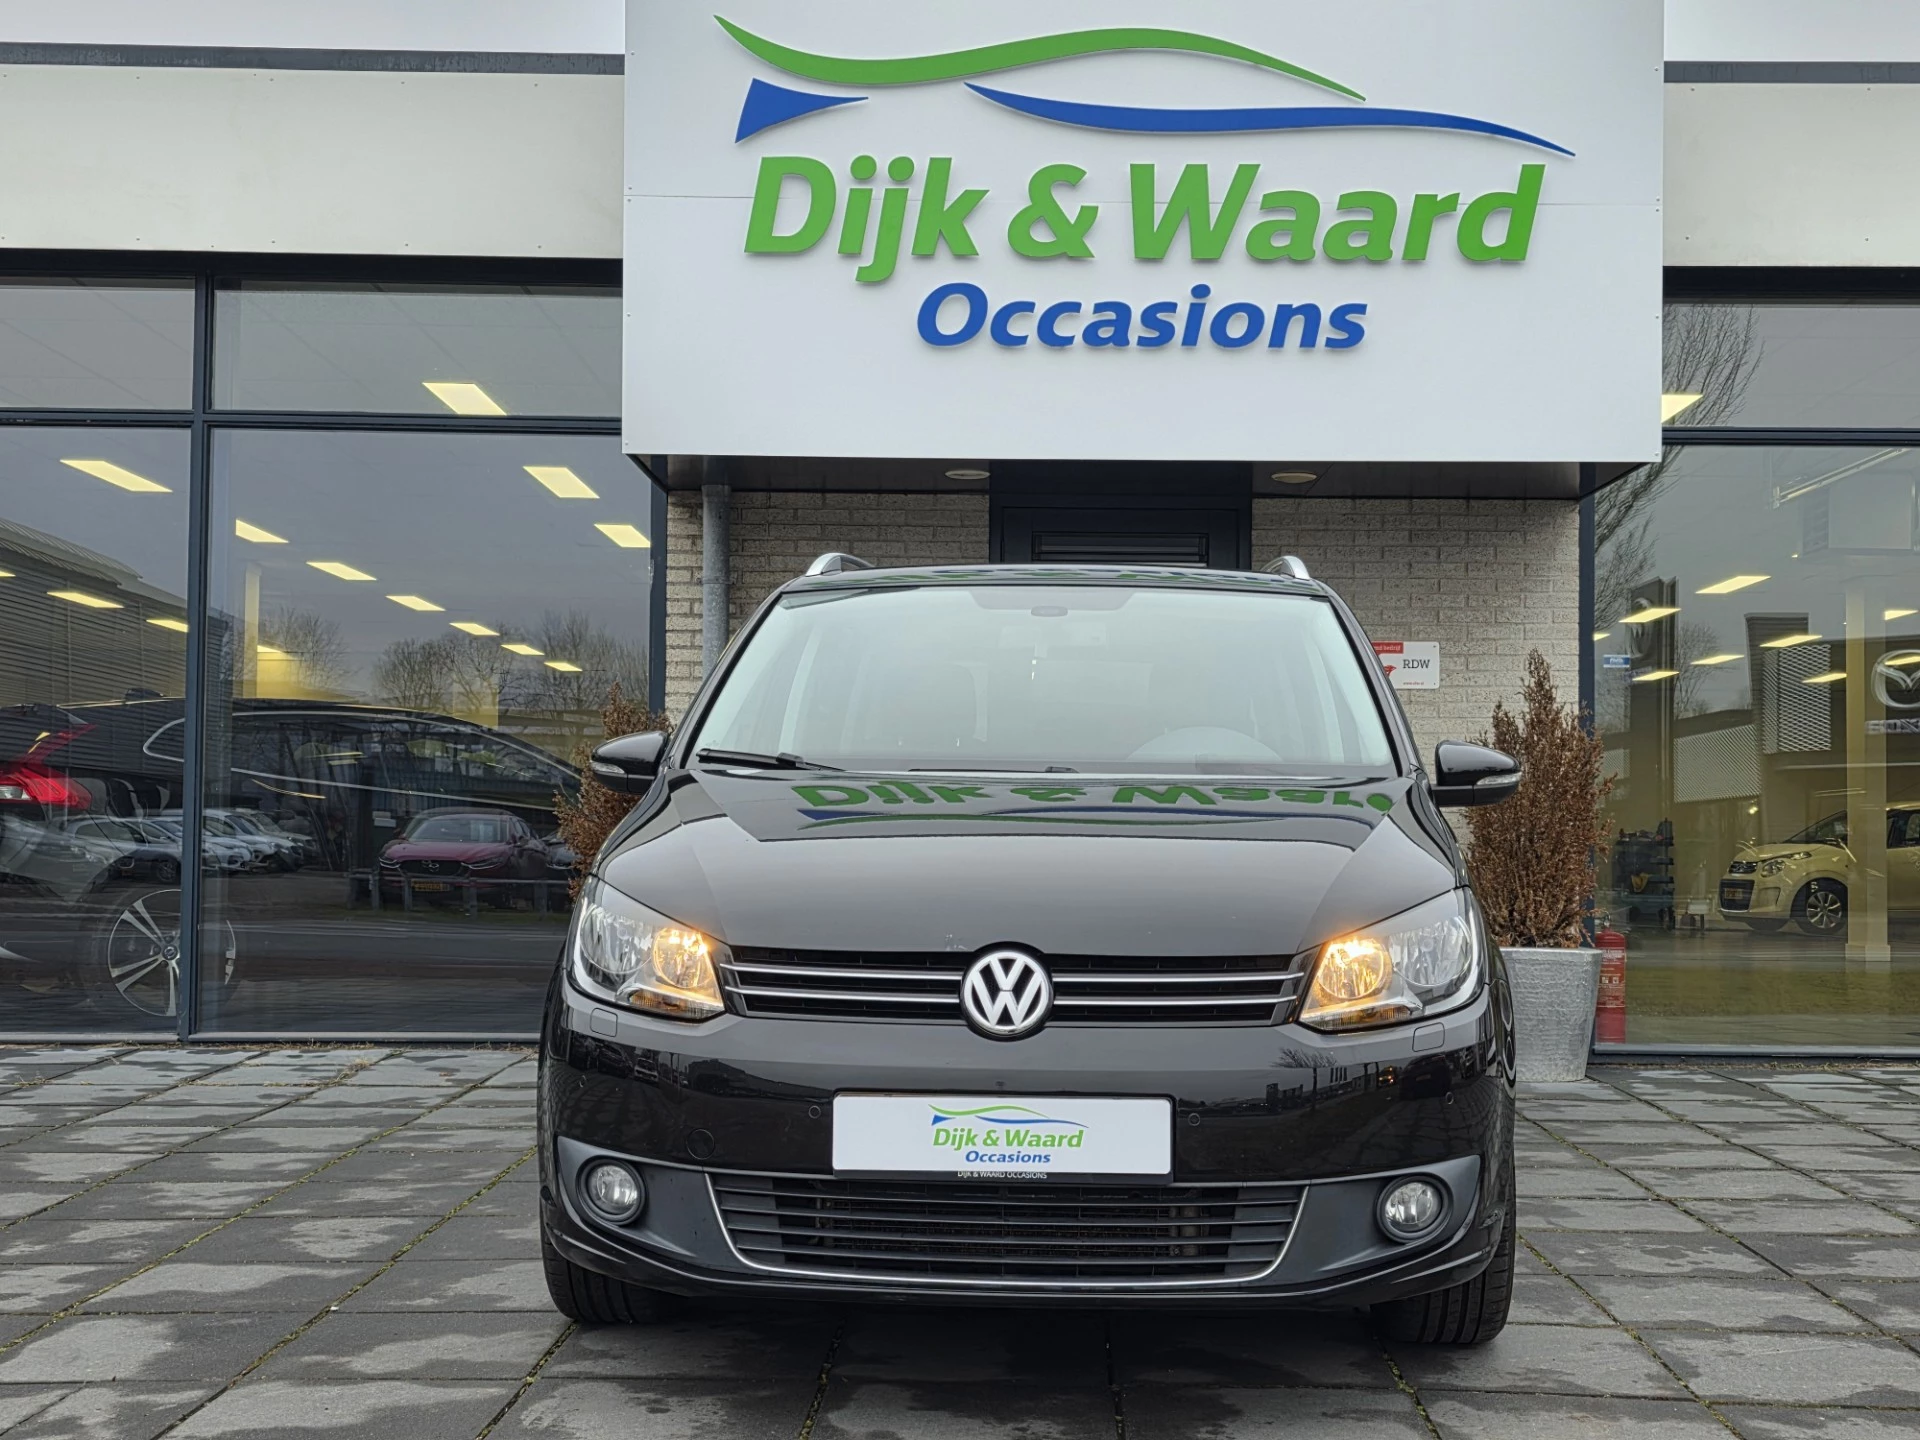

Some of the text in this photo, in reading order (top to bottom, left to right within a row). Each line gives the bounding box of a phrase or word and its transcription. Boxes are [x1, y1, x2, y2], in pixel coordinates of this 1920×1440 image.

[745, 155, 1546, 283] Dijk & Waard
[917, 283, 1367, 348] Occasions
[1402, 659, 1431, 669] RDW
[932, 1127, 1085, 1151] Dijk & Waard
[964, 1150, 1051, 1164] Occasions
[979, 1170, 1006, 1178] WAARD
[1006, 1171, 1048, 1179] OCCASIONS
